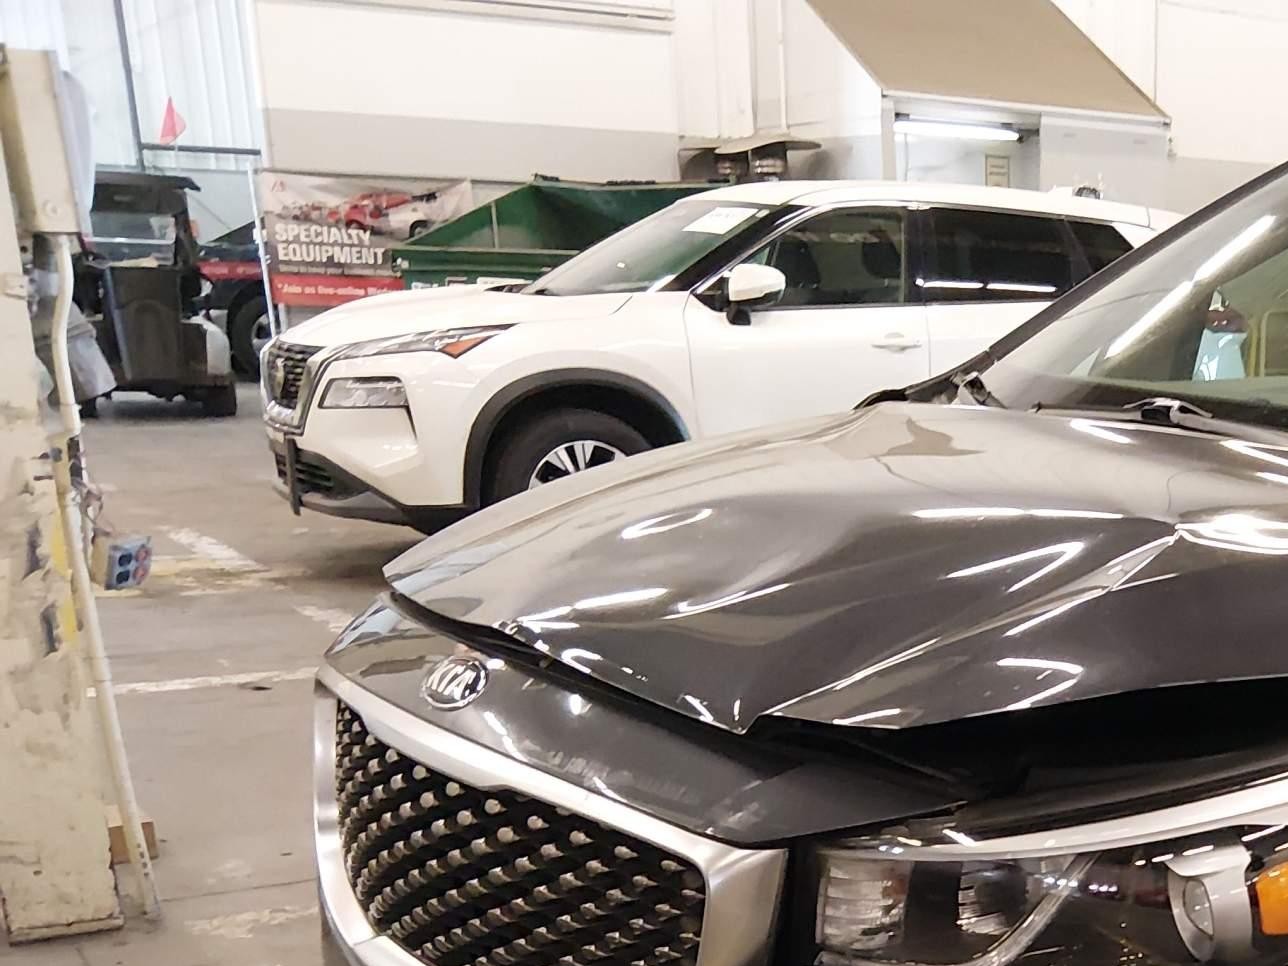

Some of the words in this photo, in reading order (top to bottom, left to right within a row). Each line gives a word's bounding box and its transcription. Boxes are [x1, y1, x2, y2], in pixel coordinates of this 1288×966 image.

[275, 223, 371, 245] SPECIALTY
[277, 243, 385, 265] EQUIPMENT
[426, 663, 477, 700] KIA
